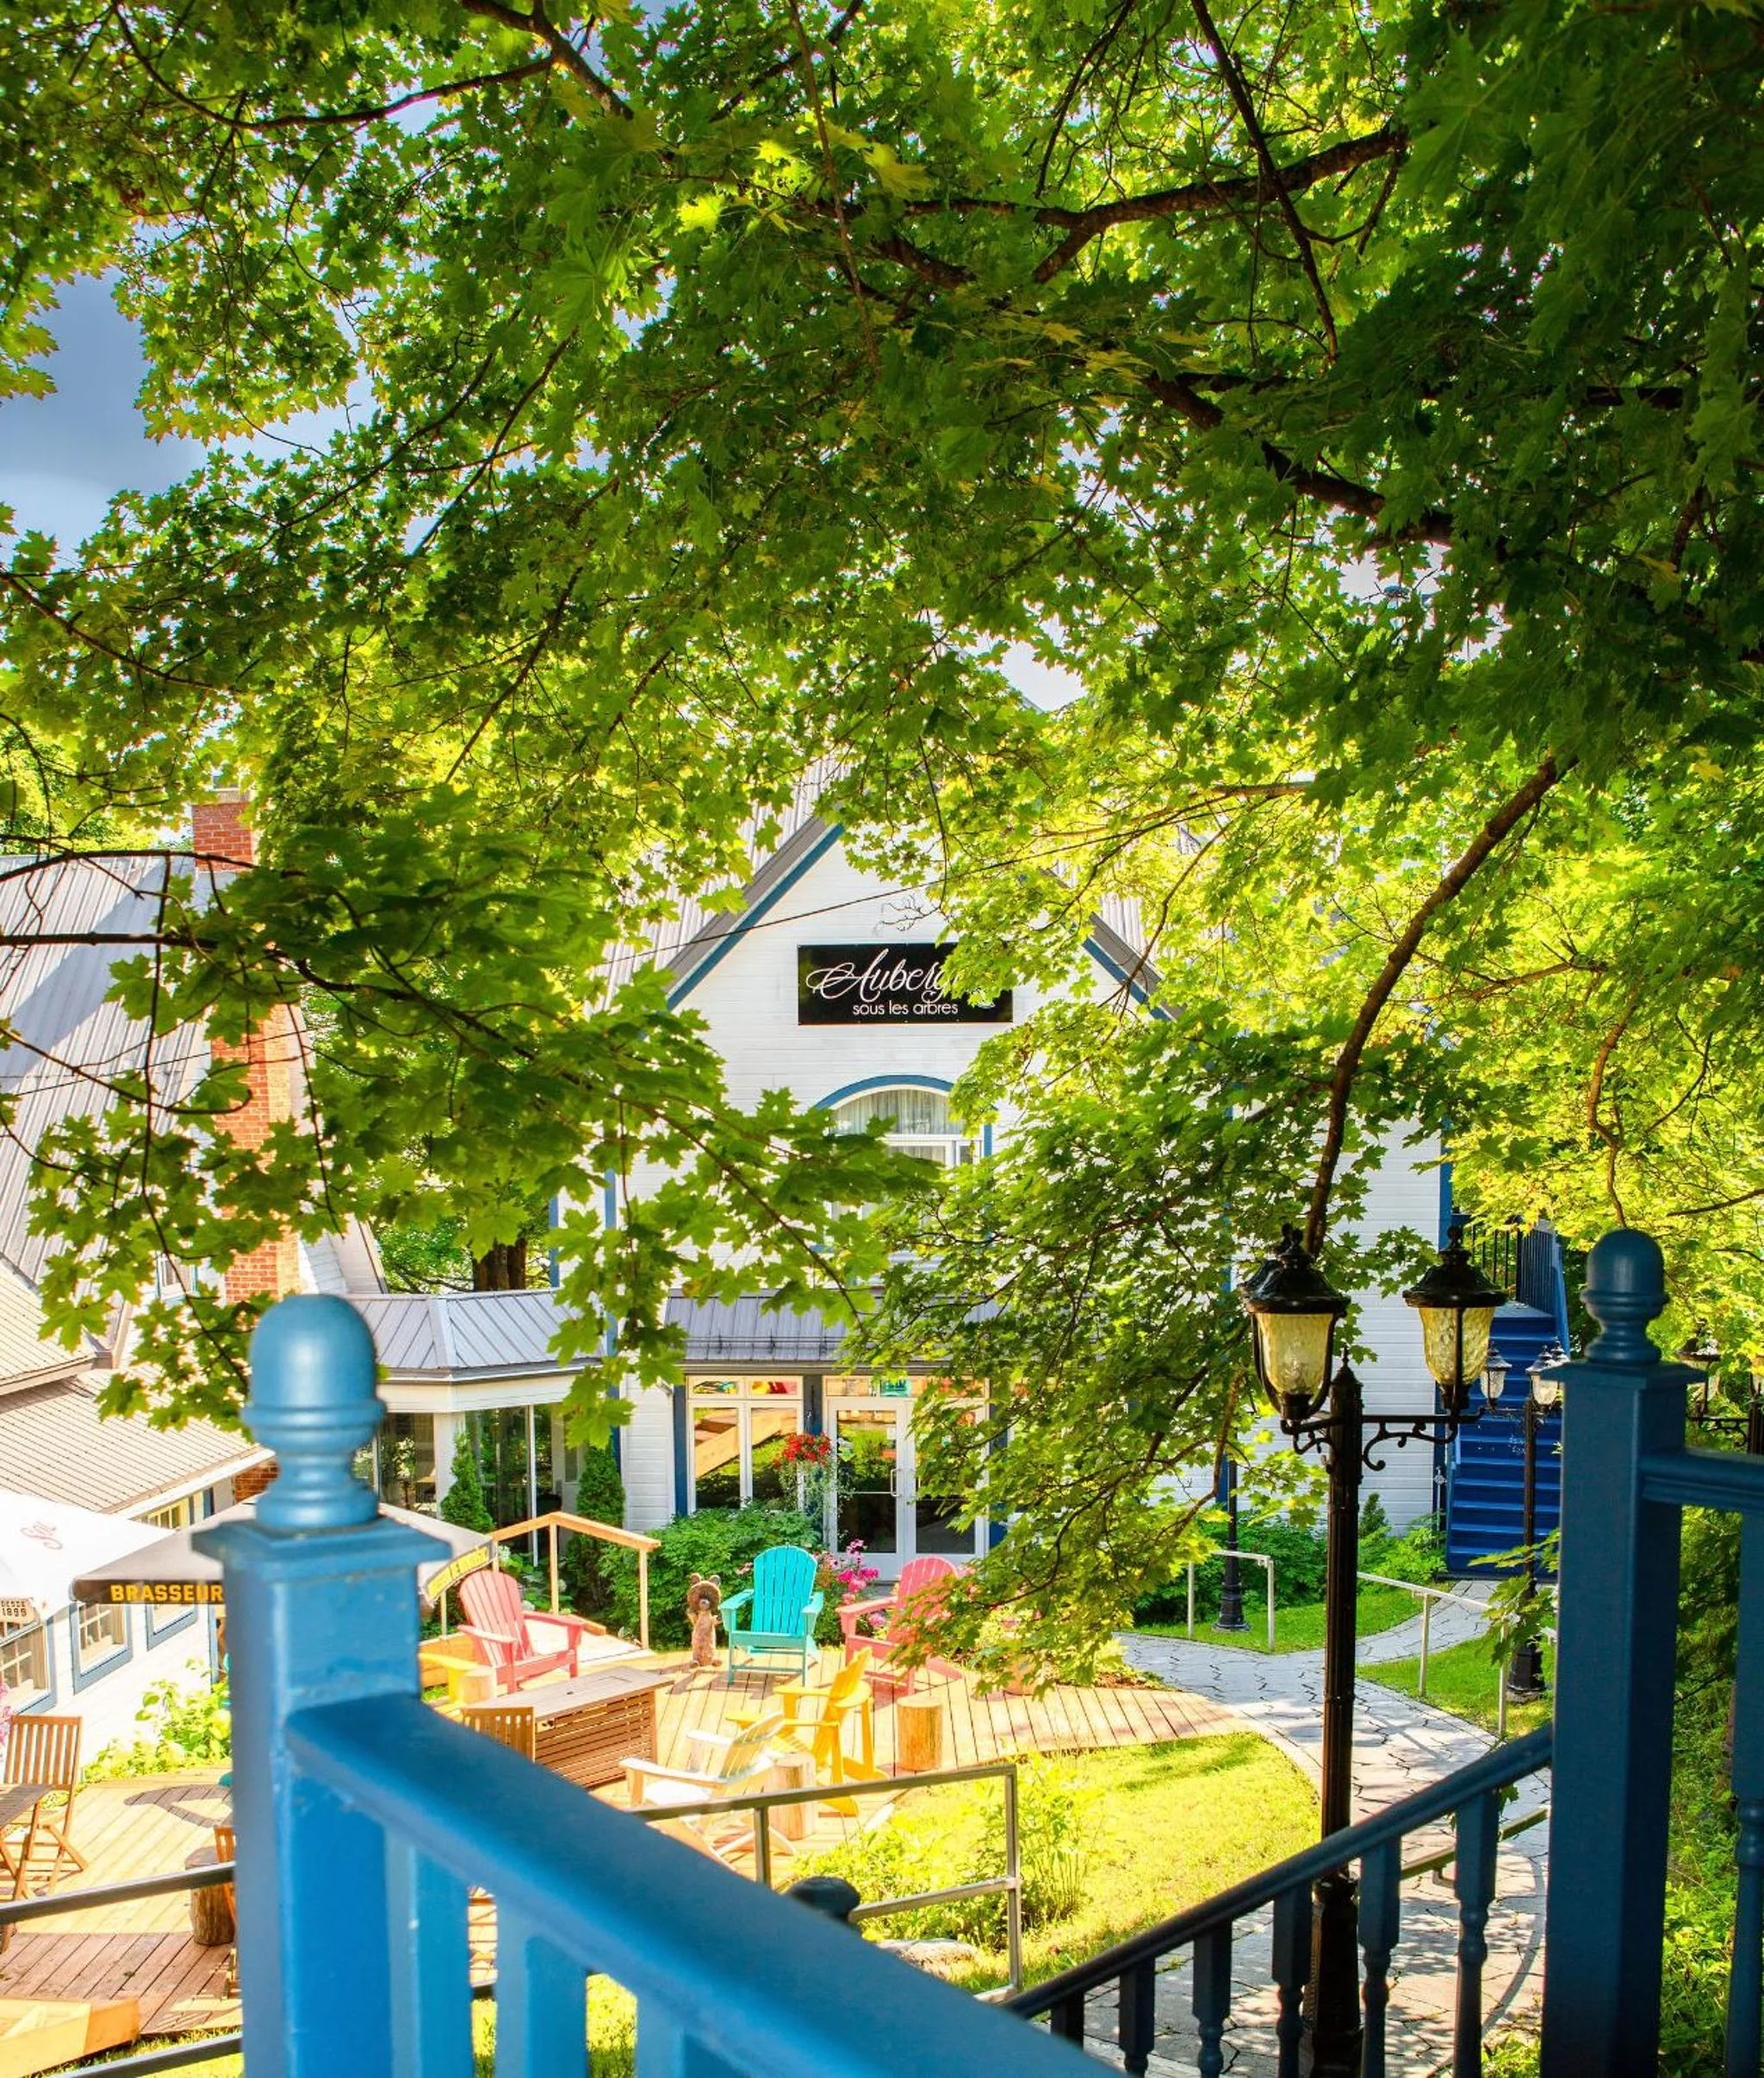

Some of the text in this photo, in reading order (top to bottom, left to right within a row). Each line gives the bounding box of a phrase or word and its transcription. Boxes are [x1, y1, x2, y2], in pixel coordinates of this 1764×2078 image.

[805, 948, 960, 1003] Auberg
[853, 1000, 959, 1015] sous les arbres
